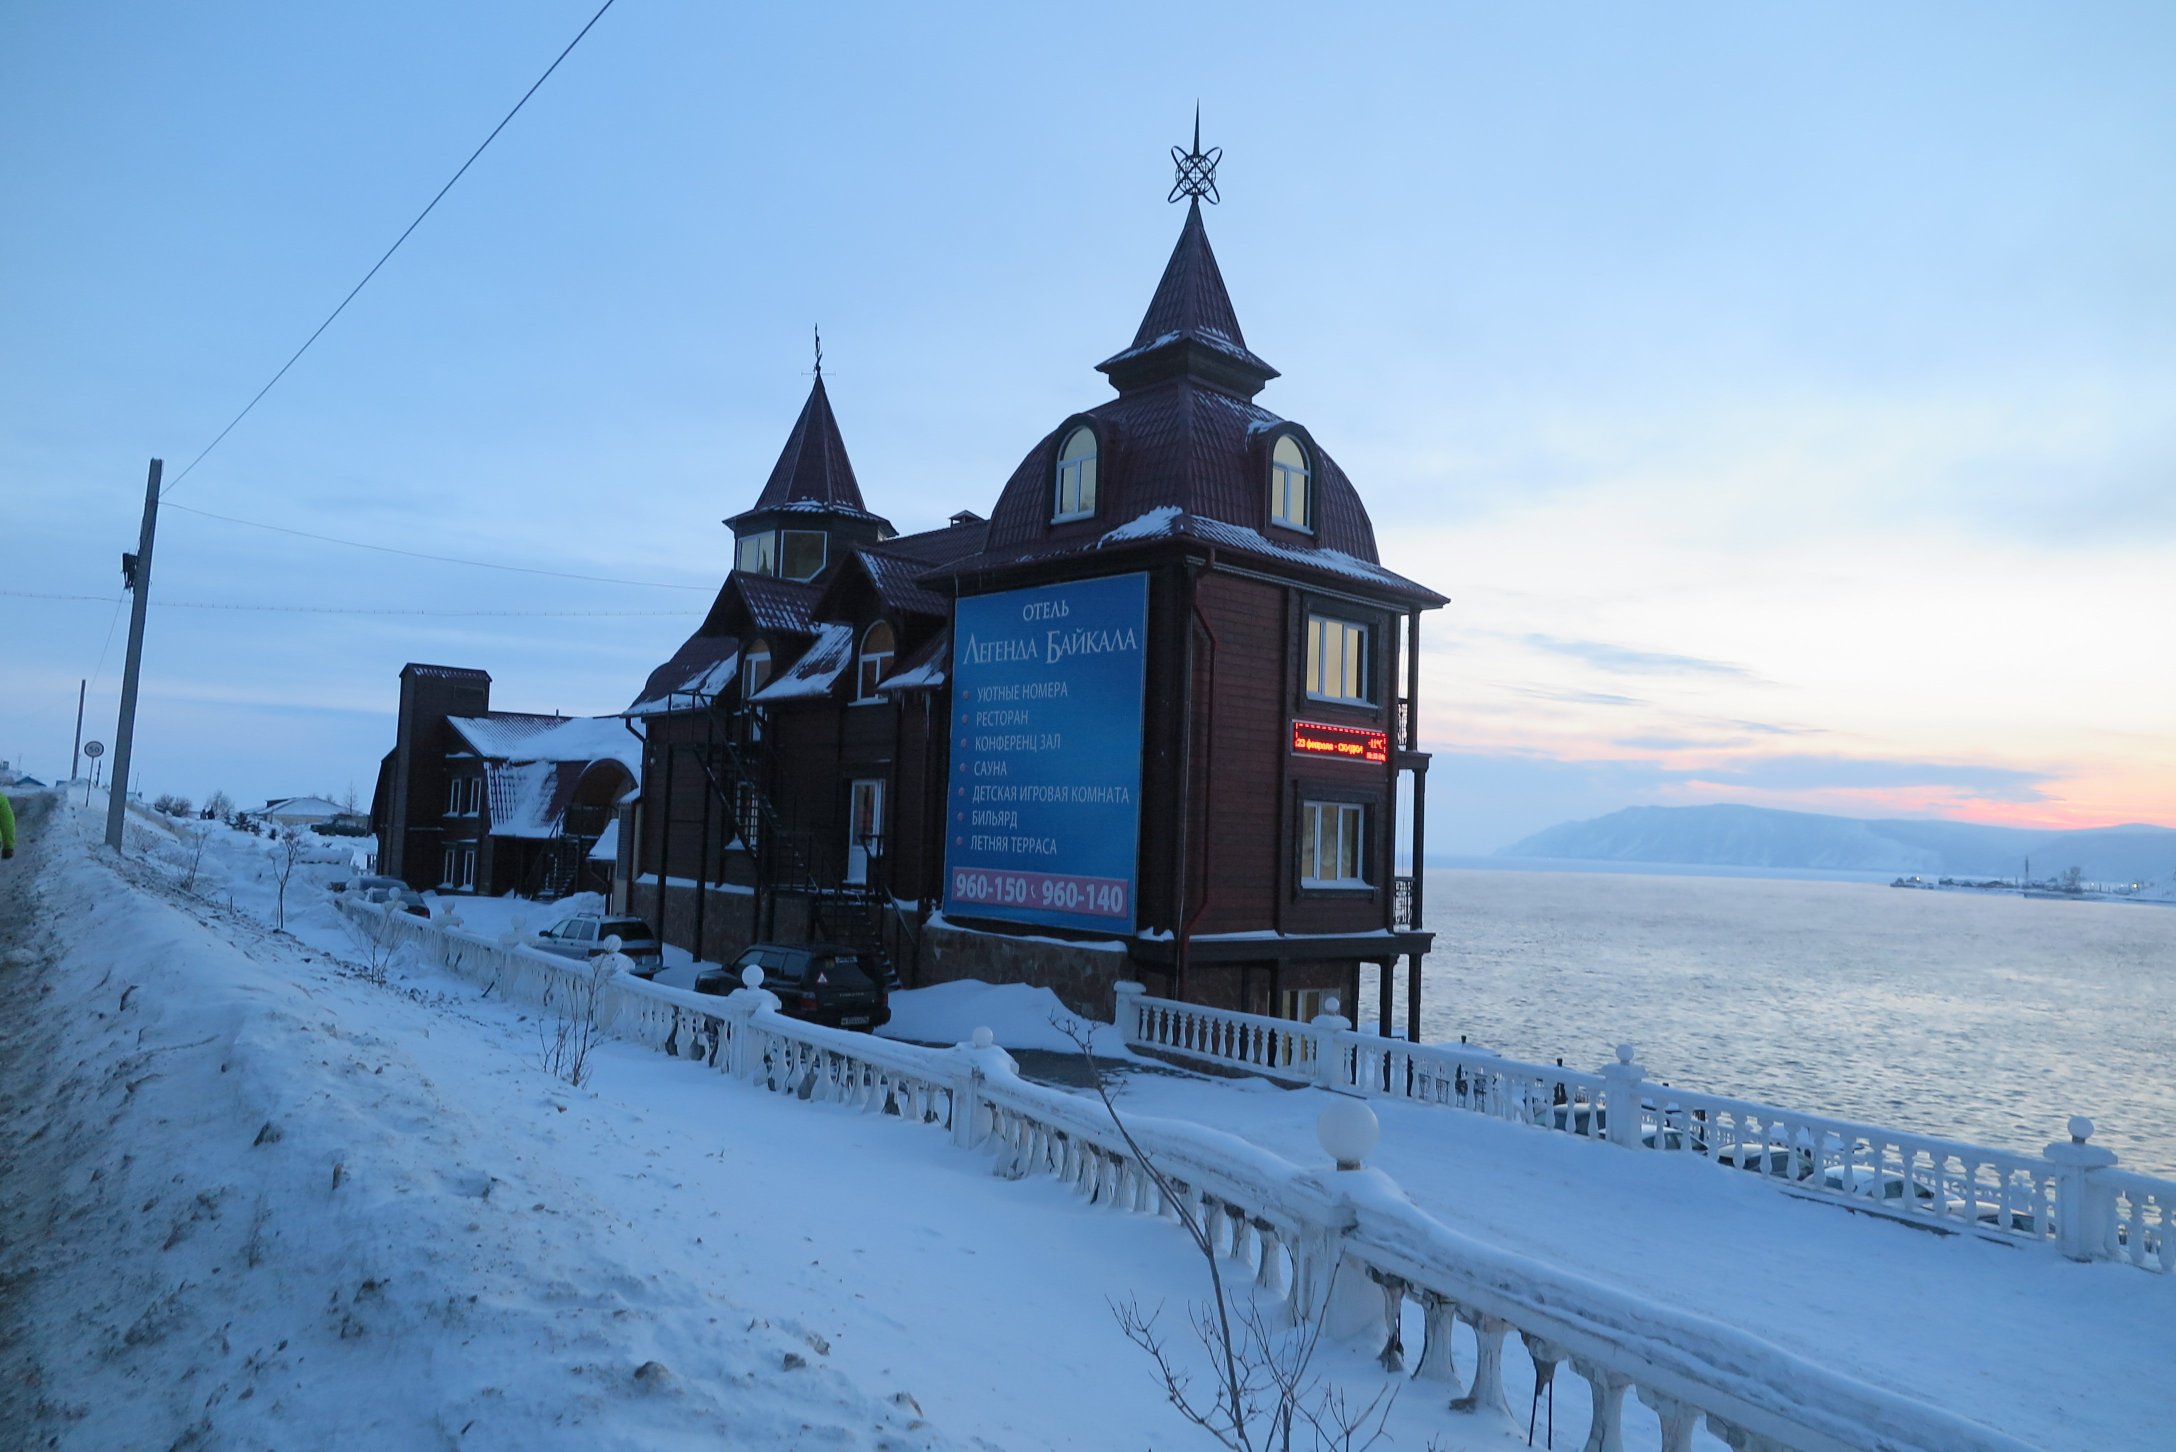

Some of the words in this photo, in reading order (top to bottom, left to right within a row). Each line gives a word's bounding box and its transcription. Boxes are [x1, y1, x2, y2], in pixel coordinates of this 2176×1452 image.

[1022, 600, 1070, 622] ОТЕЛЬ
[977, 684, 1020, 703] УЮТНЫЕ
[1022, 681, 1068, 700] НОМЕРА
[976, 710, 1029, 727] РЕСТОРАН
[975, 735, 1038, 752] КОНФЕРЕНЦ
[1040, 733, 1061, 749] ЗАЛ
[974, 761, 1007, 776] САУНА
[972, 785, 1017, 803] ДЕТСКАЯ
[1020, 785, 1068, 802] ИГРОВАЯ
[1071, 786, 1130, 804] КОМНАТА
[972, 810, 1018, 830] БИЛЬЯРД
[970, 835, 1008, 852] ЛЕТНЯЯ
[1011, 836, 1057, 855] ТЕРРАСА
[956, 873, 1027, 904] 960-150
[1042, 880, 1123, 913] 960-140
